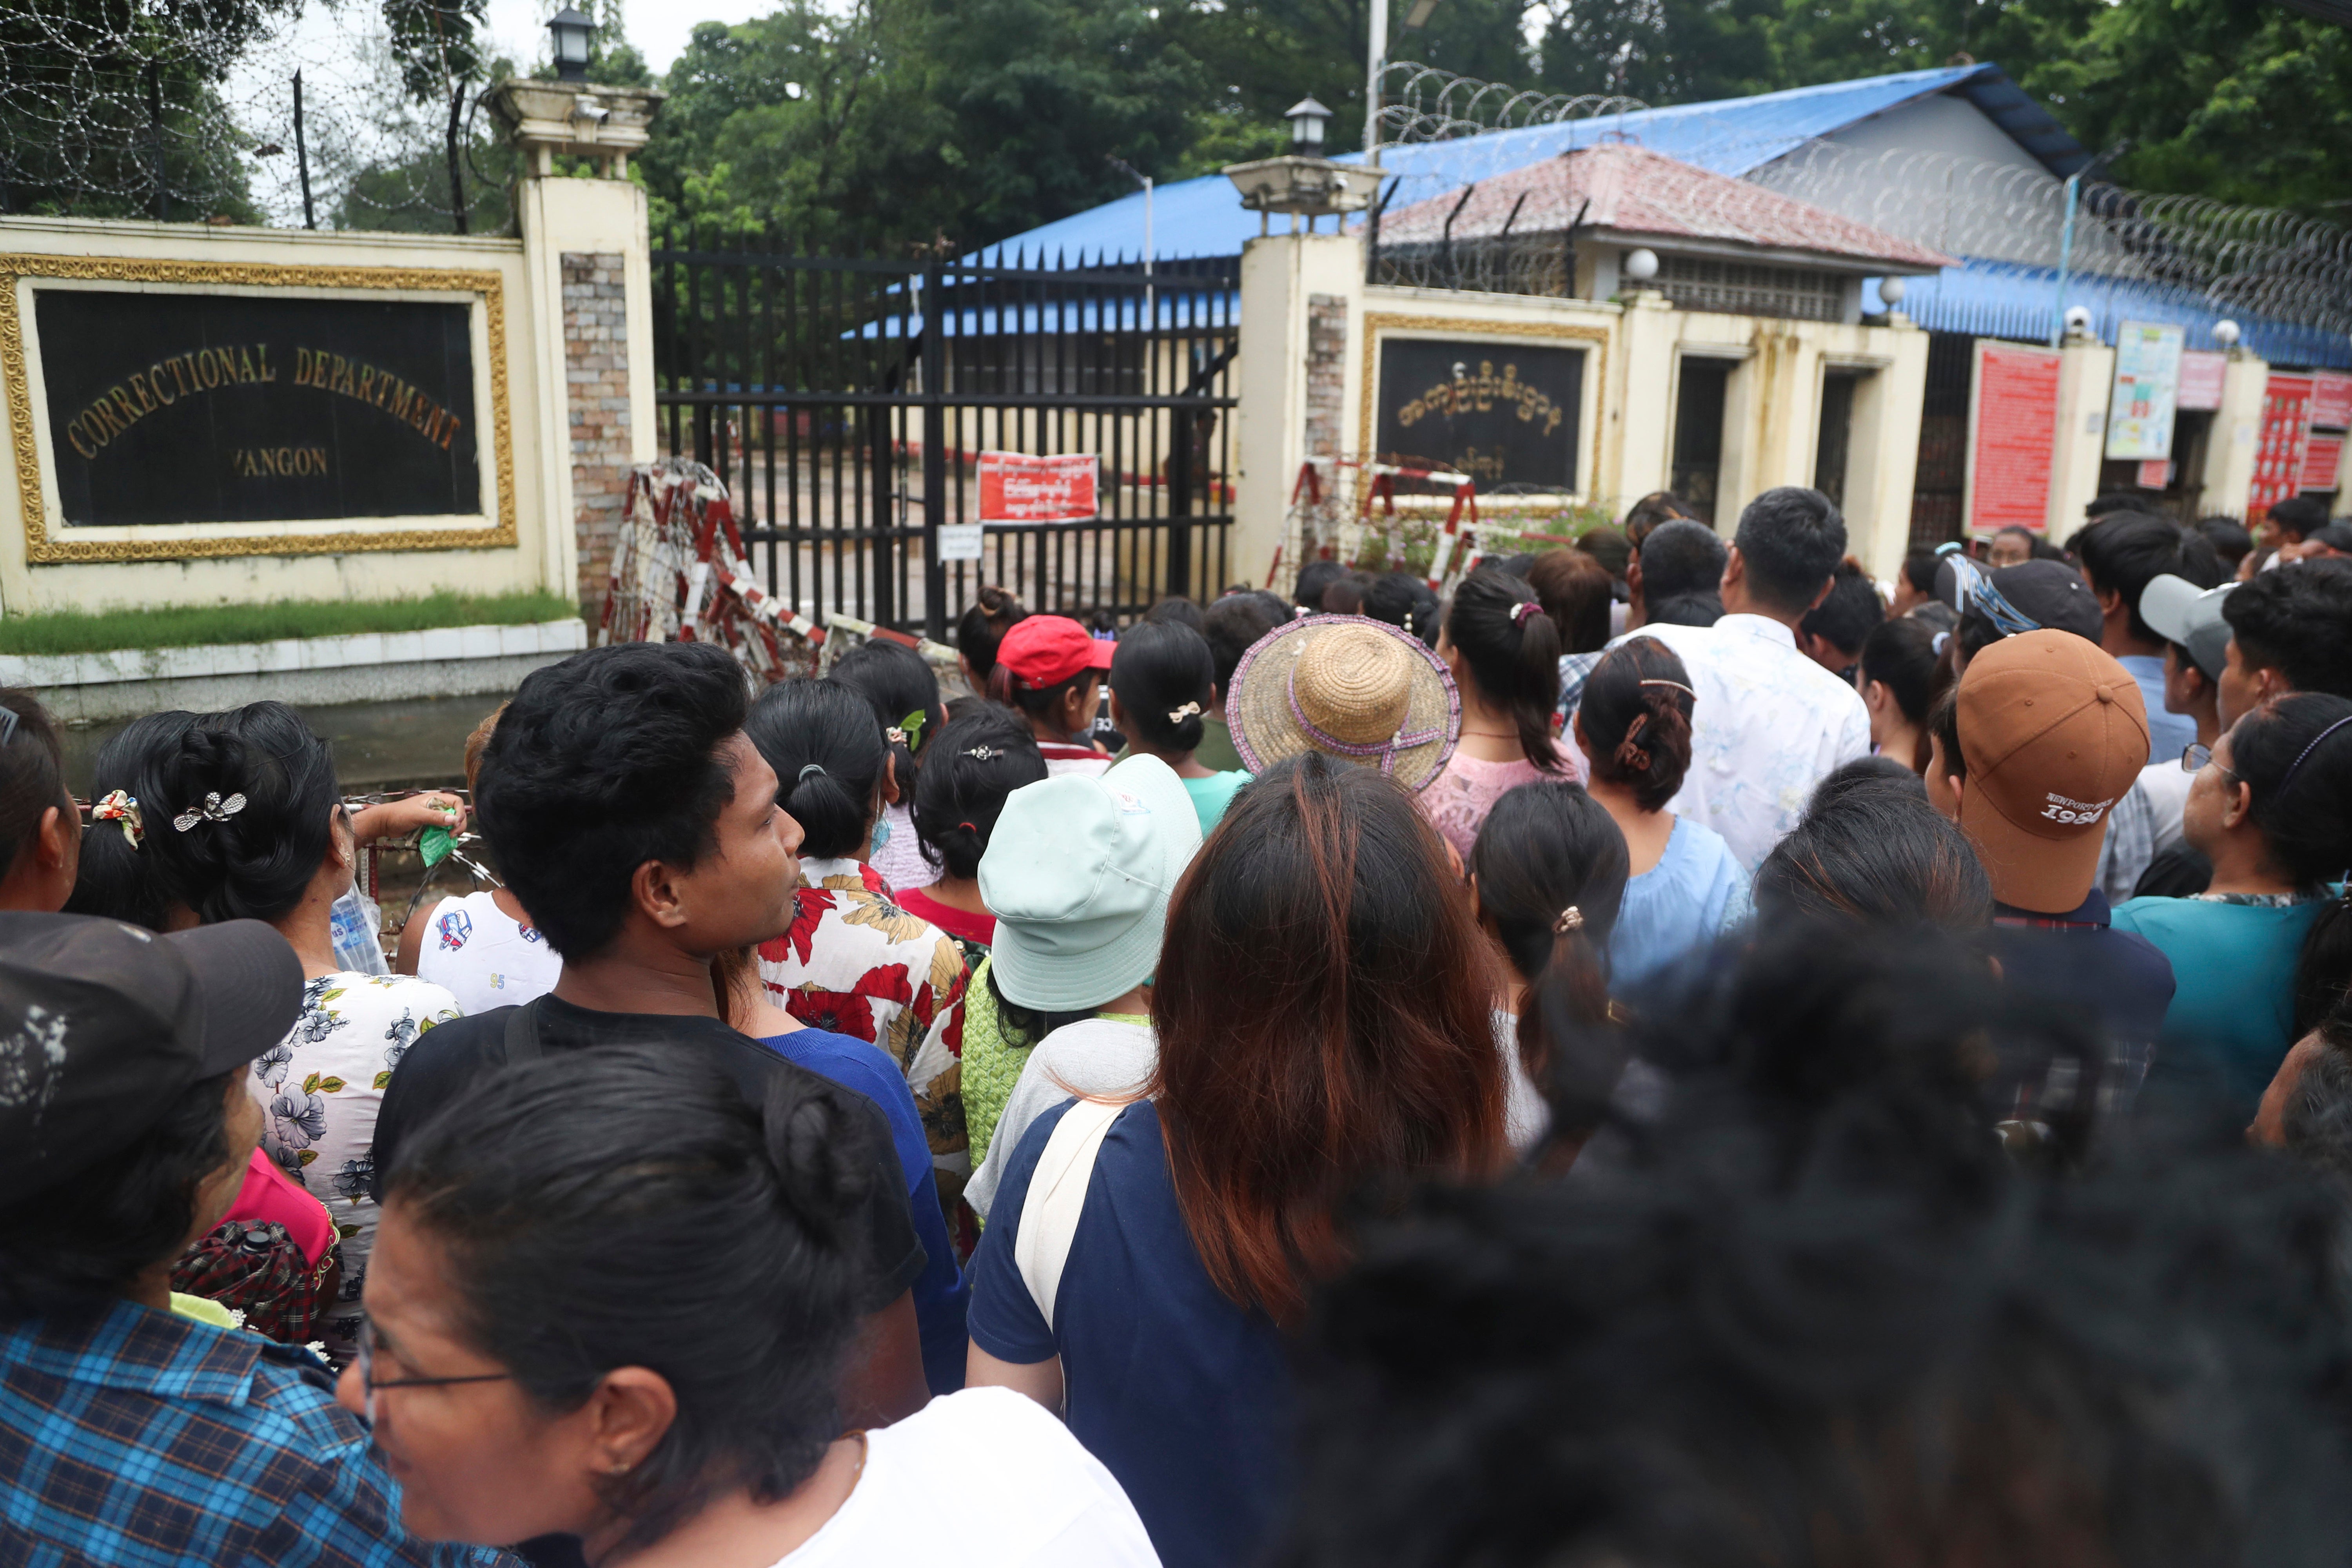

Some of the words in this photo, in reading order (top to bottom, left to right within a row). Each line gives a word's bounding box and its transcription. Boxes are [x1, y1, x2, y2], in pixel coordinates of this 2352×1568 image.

[67, 343, 276, 459] CORRECTIONAL
[294, 347, 461, 450] DEPARTMENT
[2046, 792, 2094, 811] NEWPORT
[490, 973, 505, 989] 95
